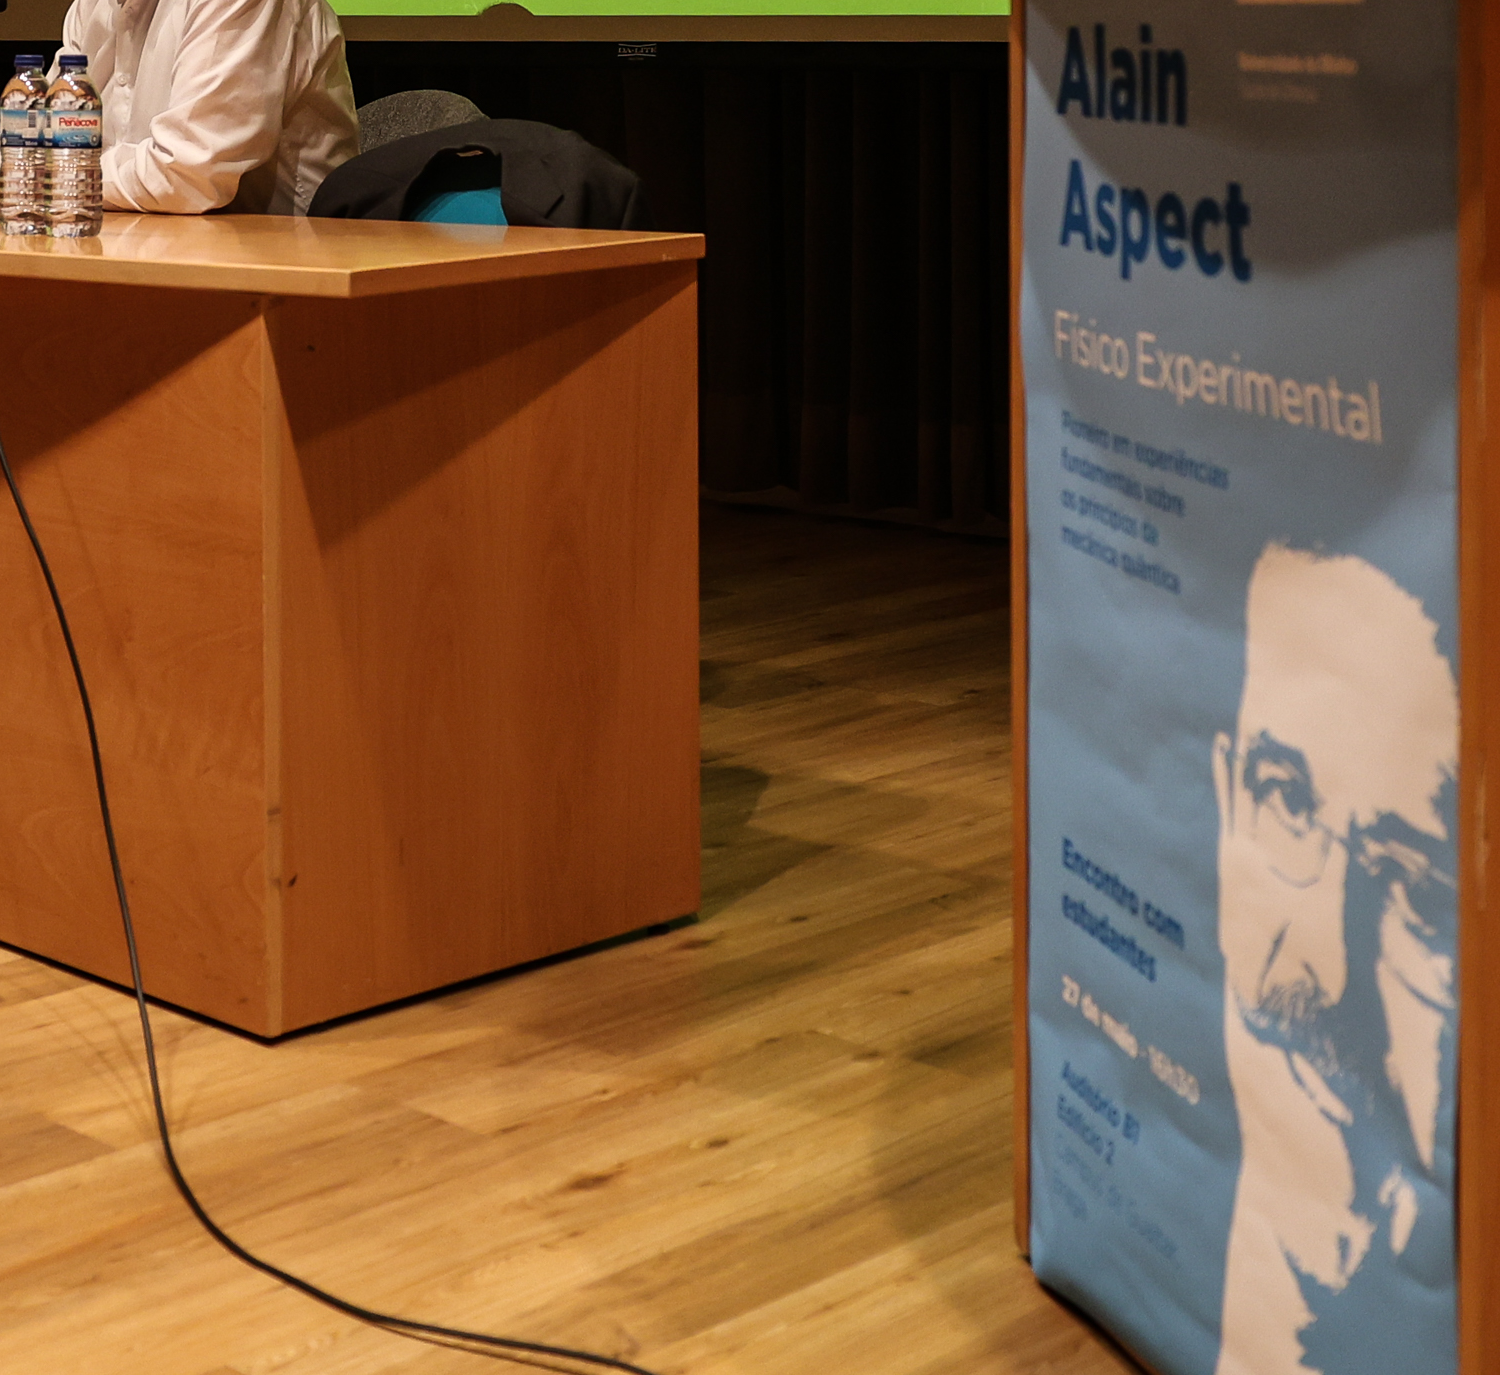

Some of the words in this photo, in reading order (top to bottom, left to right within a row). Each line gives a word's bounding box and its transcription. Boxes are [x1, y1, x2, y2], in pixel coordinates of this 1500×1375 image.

[1057, 23, 1188, 126] Alain
[1059, 159, 1252, 283] Aspect
[1135, 331, 1382, 444] Experimental
[1062, 836, 1139, 916] Encontro
[1143, 900, 1185, 951] com
